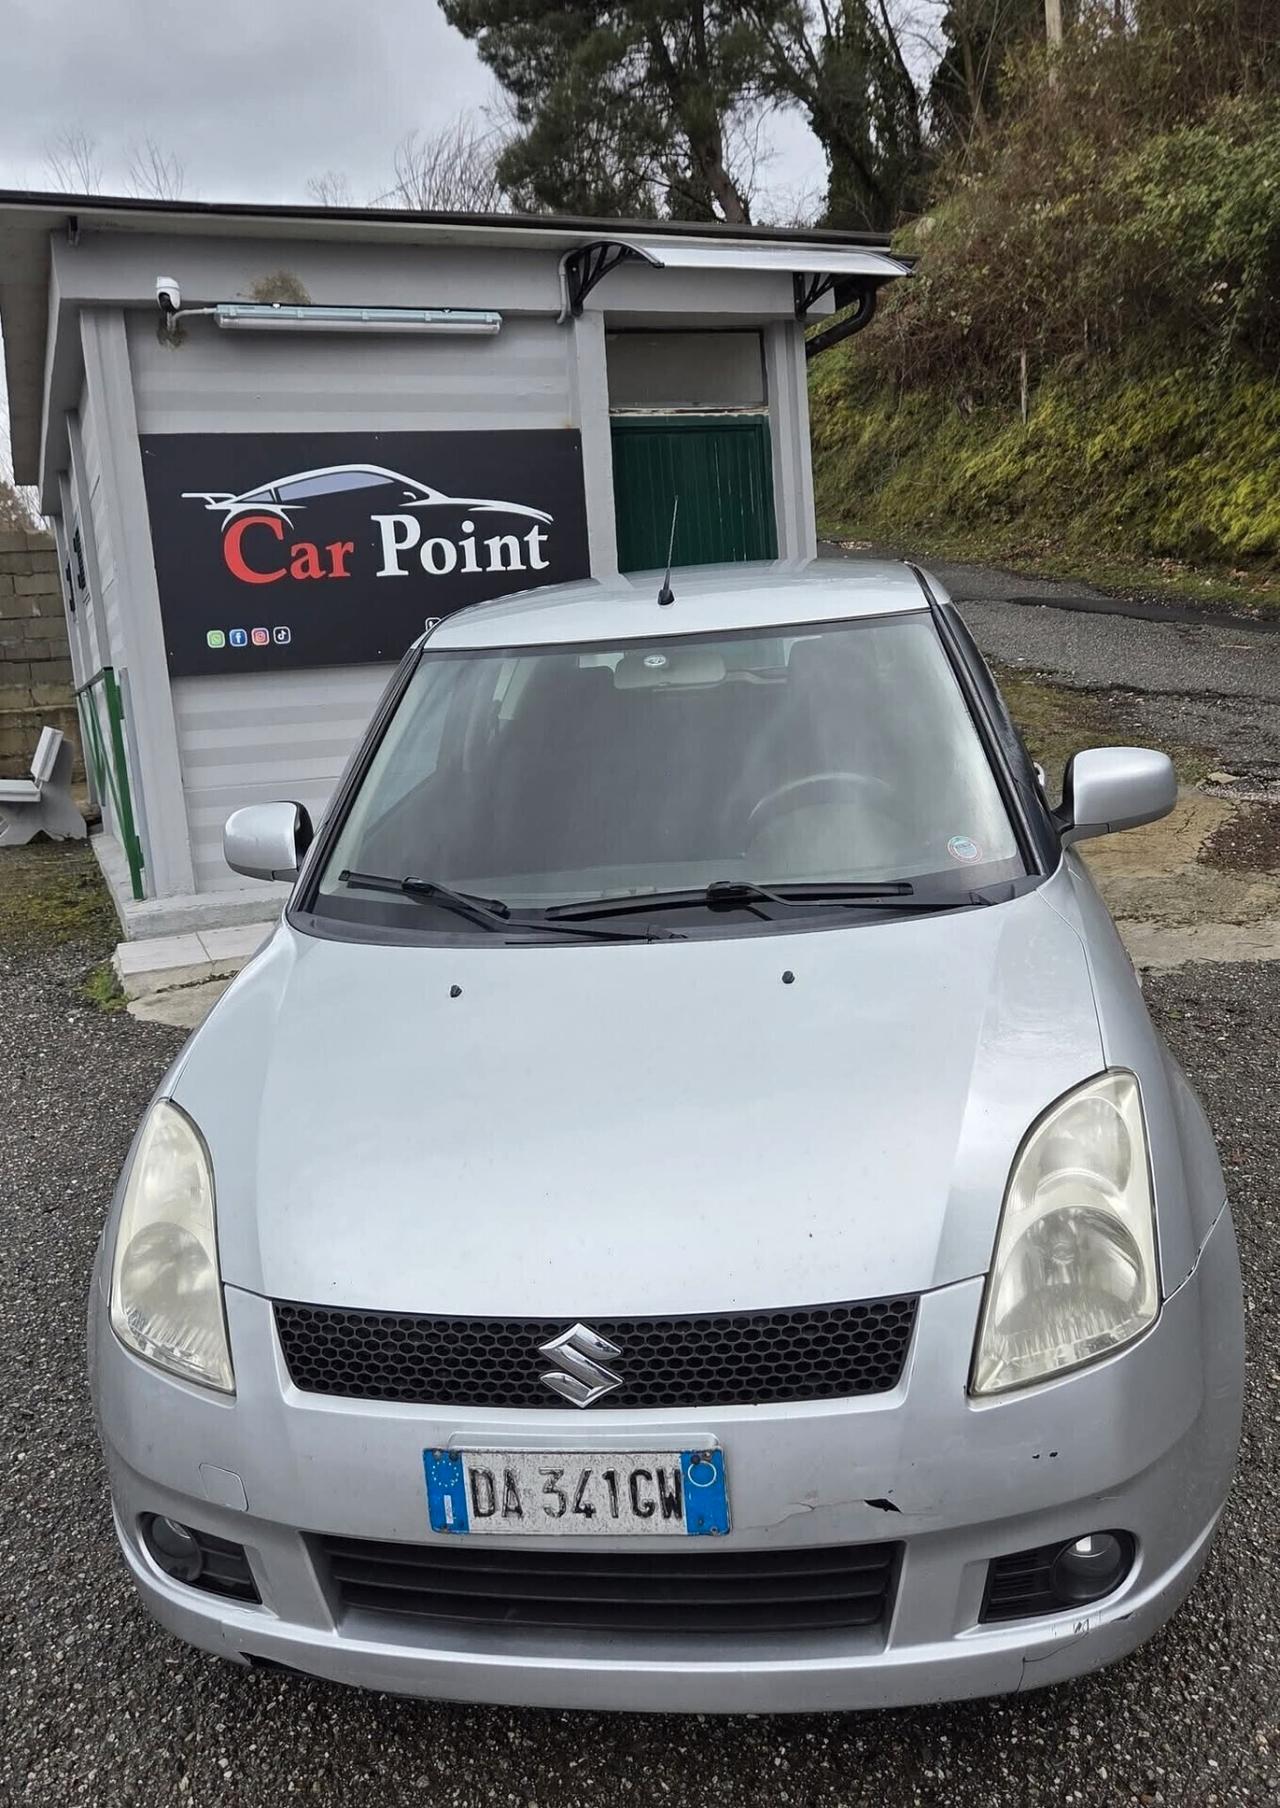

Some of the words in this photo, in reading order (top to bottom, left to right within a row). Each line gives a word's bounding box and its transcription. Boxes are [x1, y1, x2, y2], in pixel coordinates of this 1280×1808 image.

[224, 516, 353, 584] Car
[370, 514, 549, 577] Point
[469, 1468, 524, 1518] DA
[538, 1467, 684, 1519] 341GW
